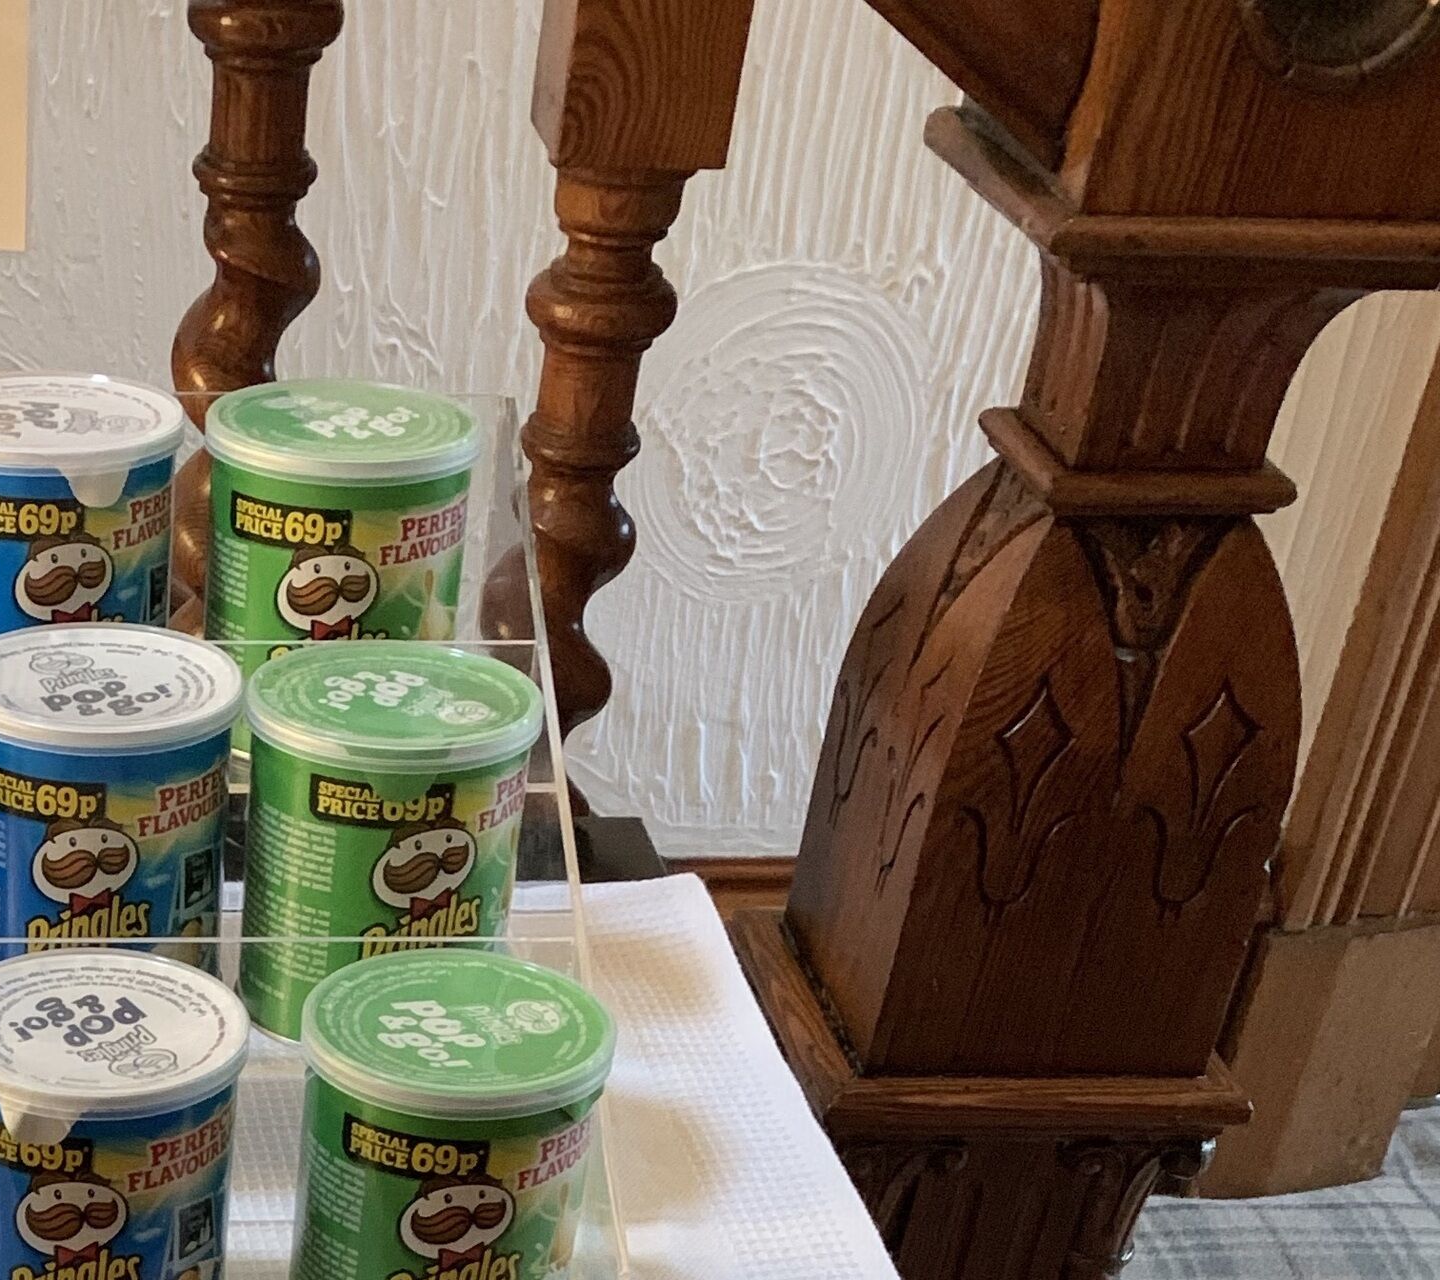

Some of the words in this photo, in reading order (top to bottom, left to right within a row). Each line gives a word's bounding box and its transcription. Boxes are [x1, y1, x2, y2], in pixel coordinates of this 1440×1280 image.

[236, 498, 284, 521] SPECIAL
[235, 515, 284, 540] PRICE
[40, 666, 118, 694] Pringles
[317, 798, 380, 821] PRICE
[27, 896, 150, 953] Pringles
[361, 897, 481, 960] Pringles
[77, 1024, 158, 1062] Pringles
[351, 1122, 410, 1151] SPECIAL
[350, 1136, 409, 1169] PRICE
